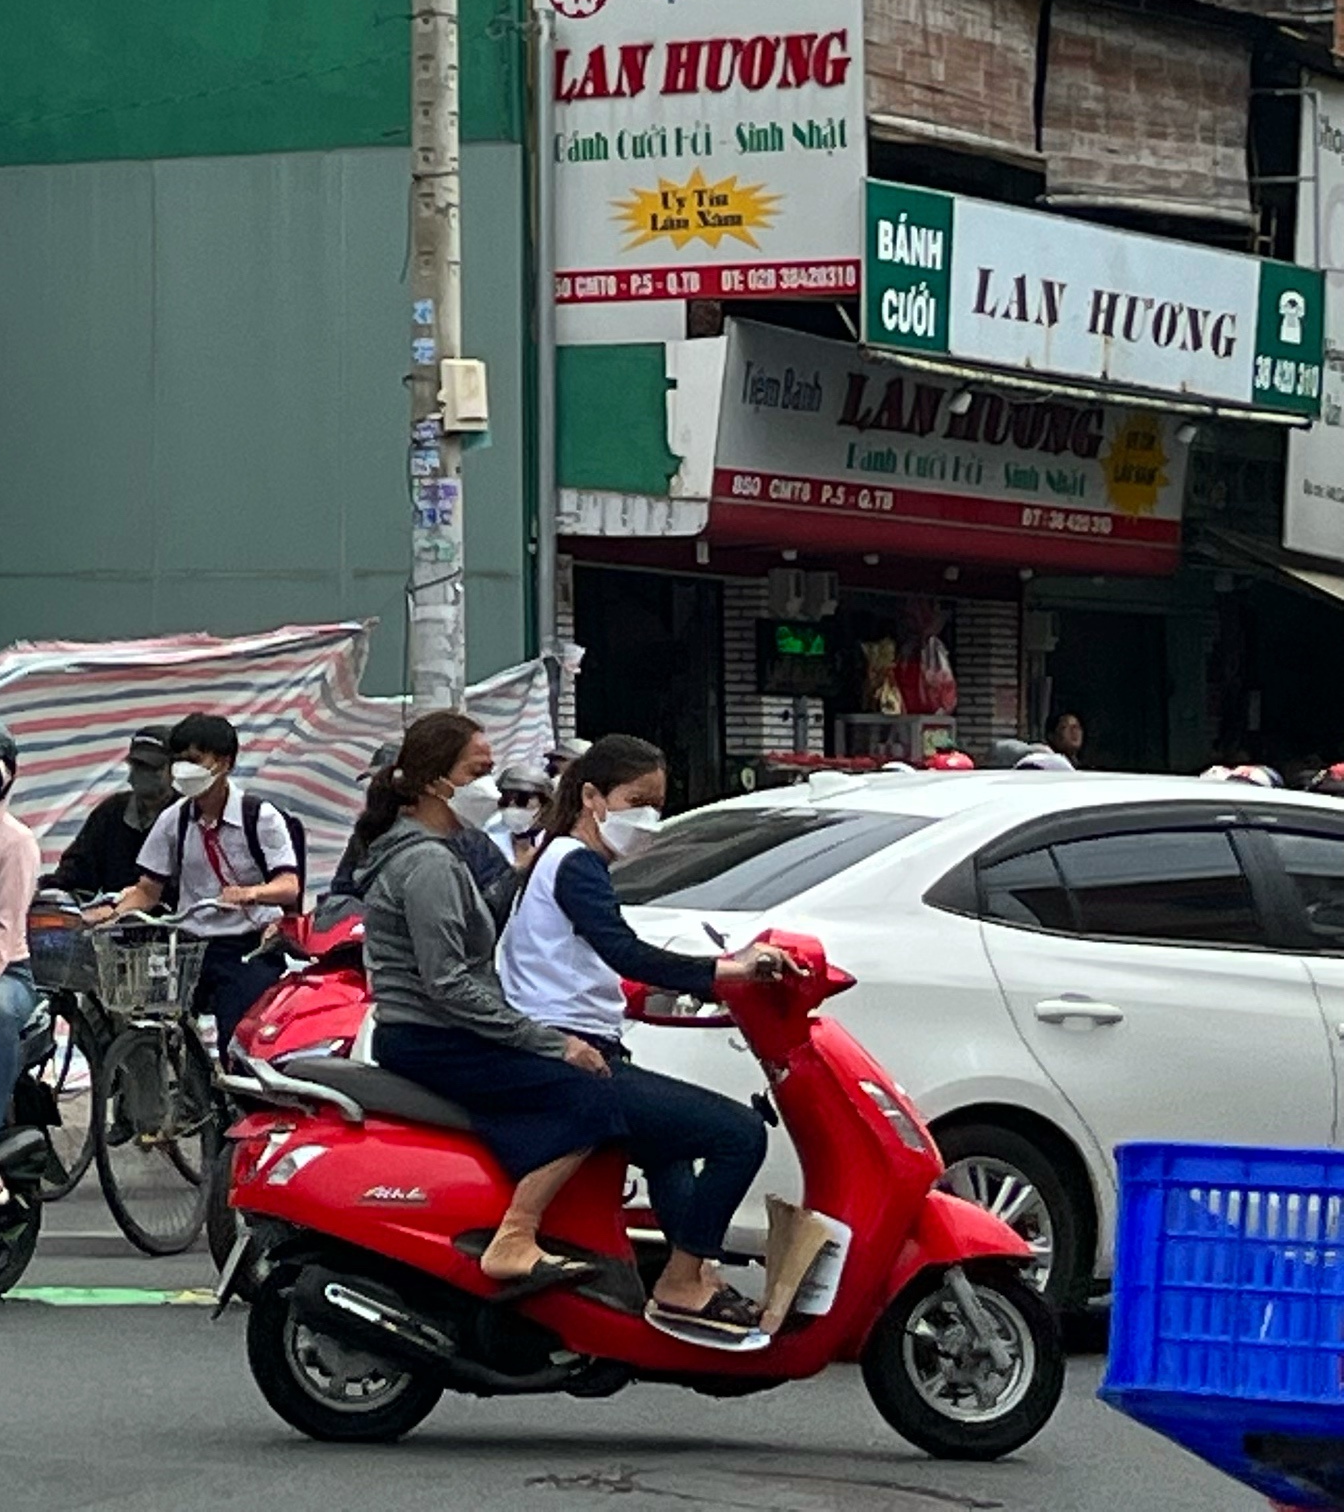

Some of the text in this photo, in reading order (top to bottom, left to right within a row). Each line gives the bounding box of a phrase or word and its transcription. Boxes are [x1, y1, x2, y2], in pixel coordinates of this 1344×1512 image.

[554, 28, 851, 106] LAN HƯƠNG
[617, 123, 667, 160] Cưới
[735, 120, 784, 155] Sinh
[792, 117, 848, 157] Nhật
[877, 213, 944, 271] BÁNH
[881, 281, 936, 338] CƯỚI
[973, 266, 1238, 360] LAN HƯƠNG
[741, 360, 822, 414] Tiệm Bánh
[836, 371, 947, 438] LAN
